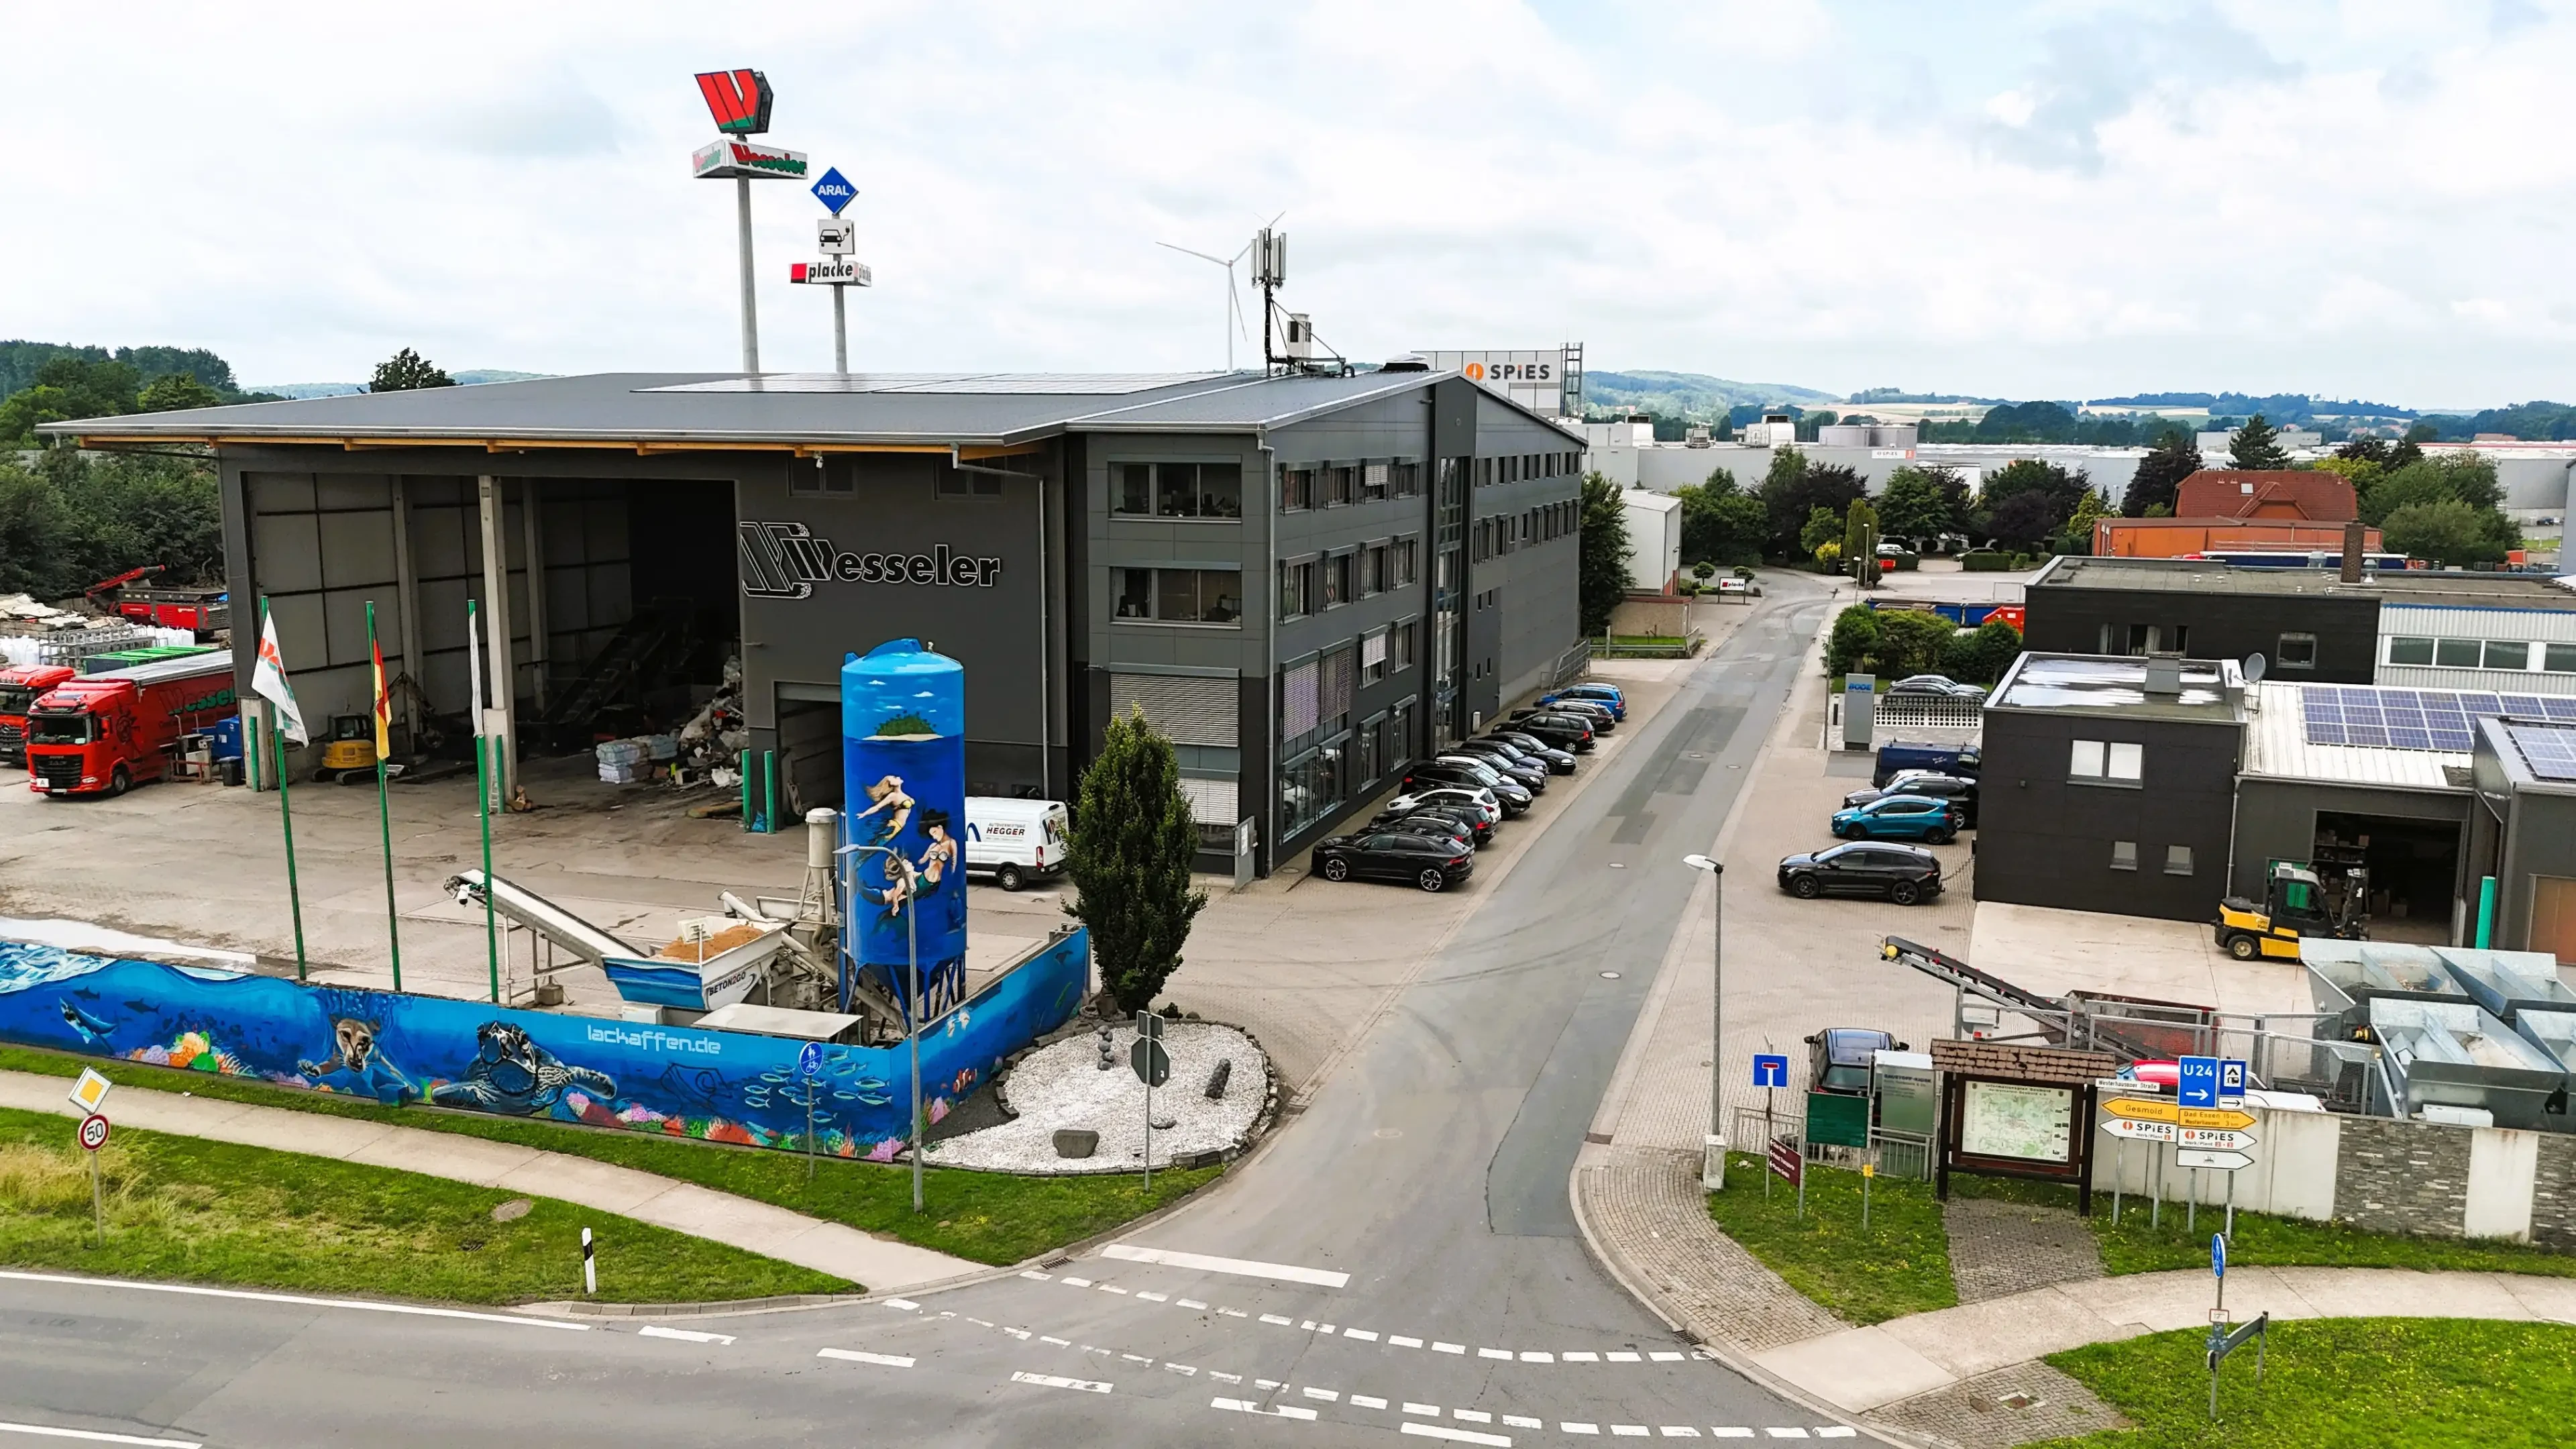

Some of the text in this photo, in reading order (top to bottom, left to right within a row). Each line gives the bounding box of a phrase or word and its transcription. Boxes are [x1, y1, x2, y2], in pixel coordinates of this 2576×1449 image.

[729, 142, 807, 176] Wesseler
[818, 184, 850, 196] ARAL
[808, 260, 853, 283] placke
[780, 538, 1000, 587] Wesseler
[158, 679, 236, 716] Wessel
[986, 826, 1025, 836] HEGGER
[708, 971, 746, 996] BETON2GO
[587, 1024, 721, 1055] lackaffen.de
[2125, 1104, 2163, 1115] Gesmold
[87, 1122, 103, 1142] 50
